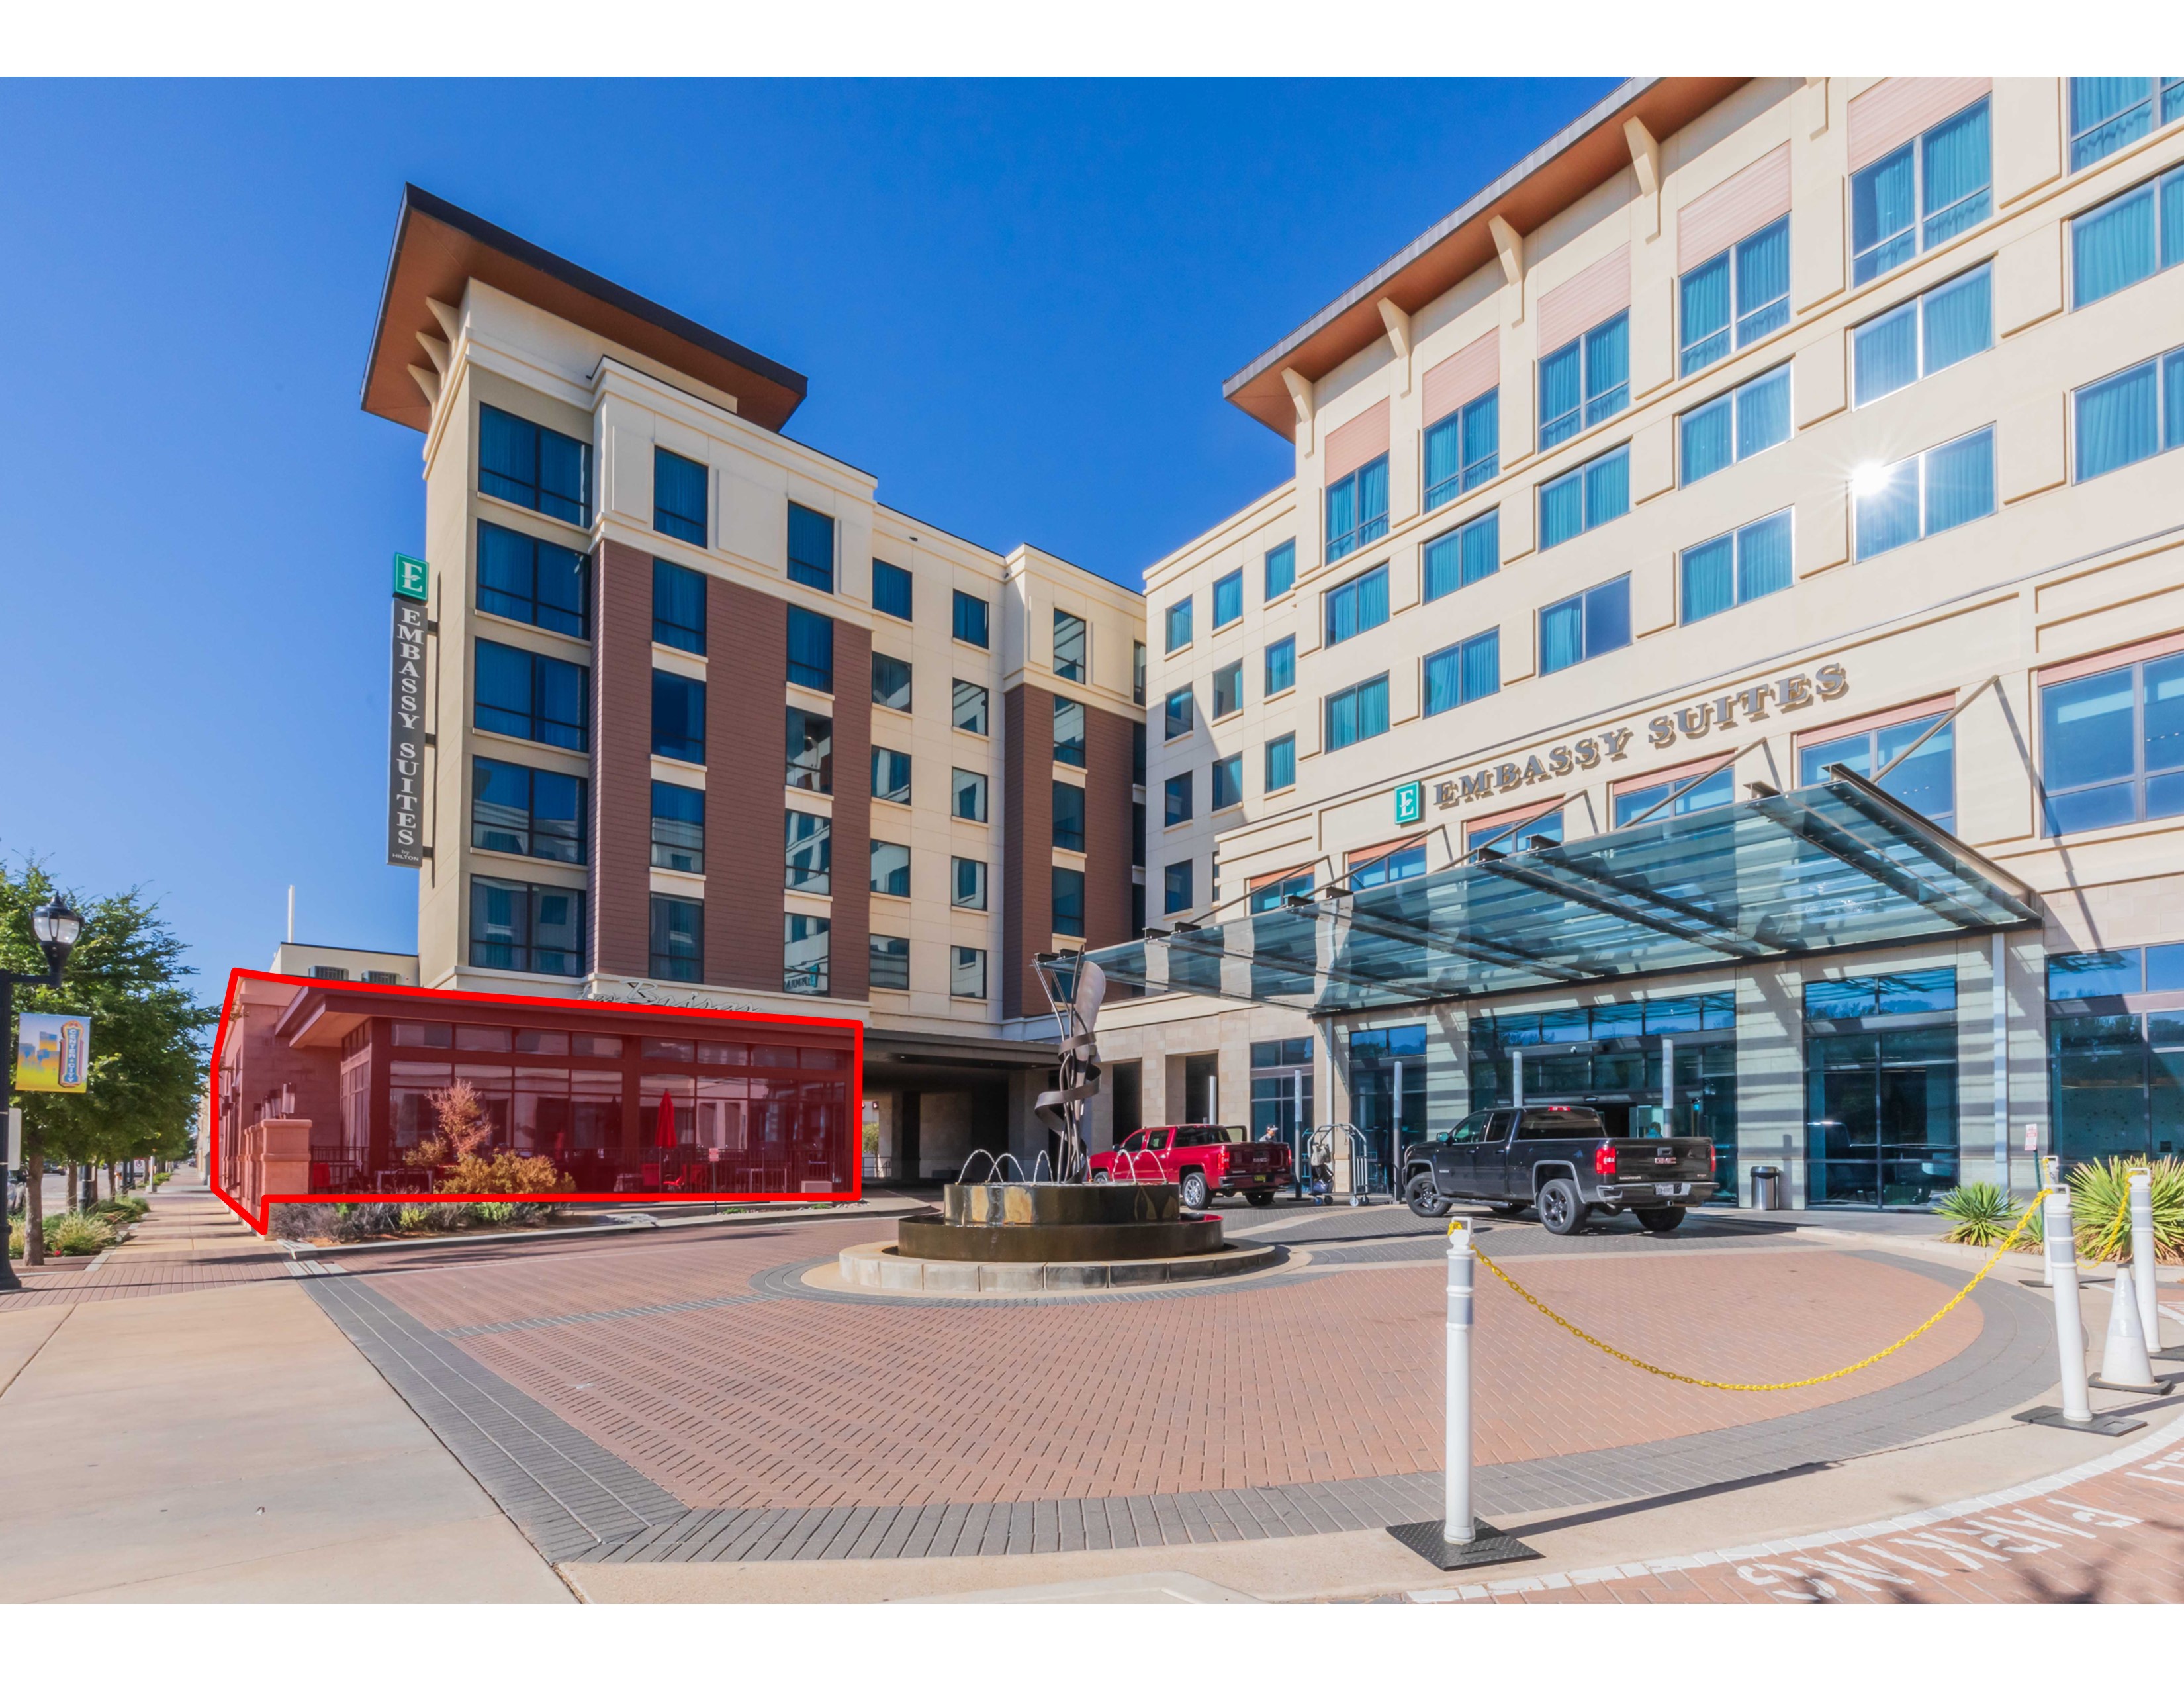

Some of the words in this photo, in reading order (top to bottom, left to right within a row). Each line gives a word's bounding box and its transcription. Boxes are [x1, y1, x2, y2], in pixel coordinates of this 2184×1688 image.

[402, 561, 424, 592] E
[397, 608, 424, 730] EMBASSY
[1433, 727, 1629, 806] EMBASSY
[1647, 662, 1844, 744] SUITES
[396, 742, 420, 846] SUITES
[1399, 789, 1414, 818] E
[1736, 1498, 2145, 1601] PARKING
